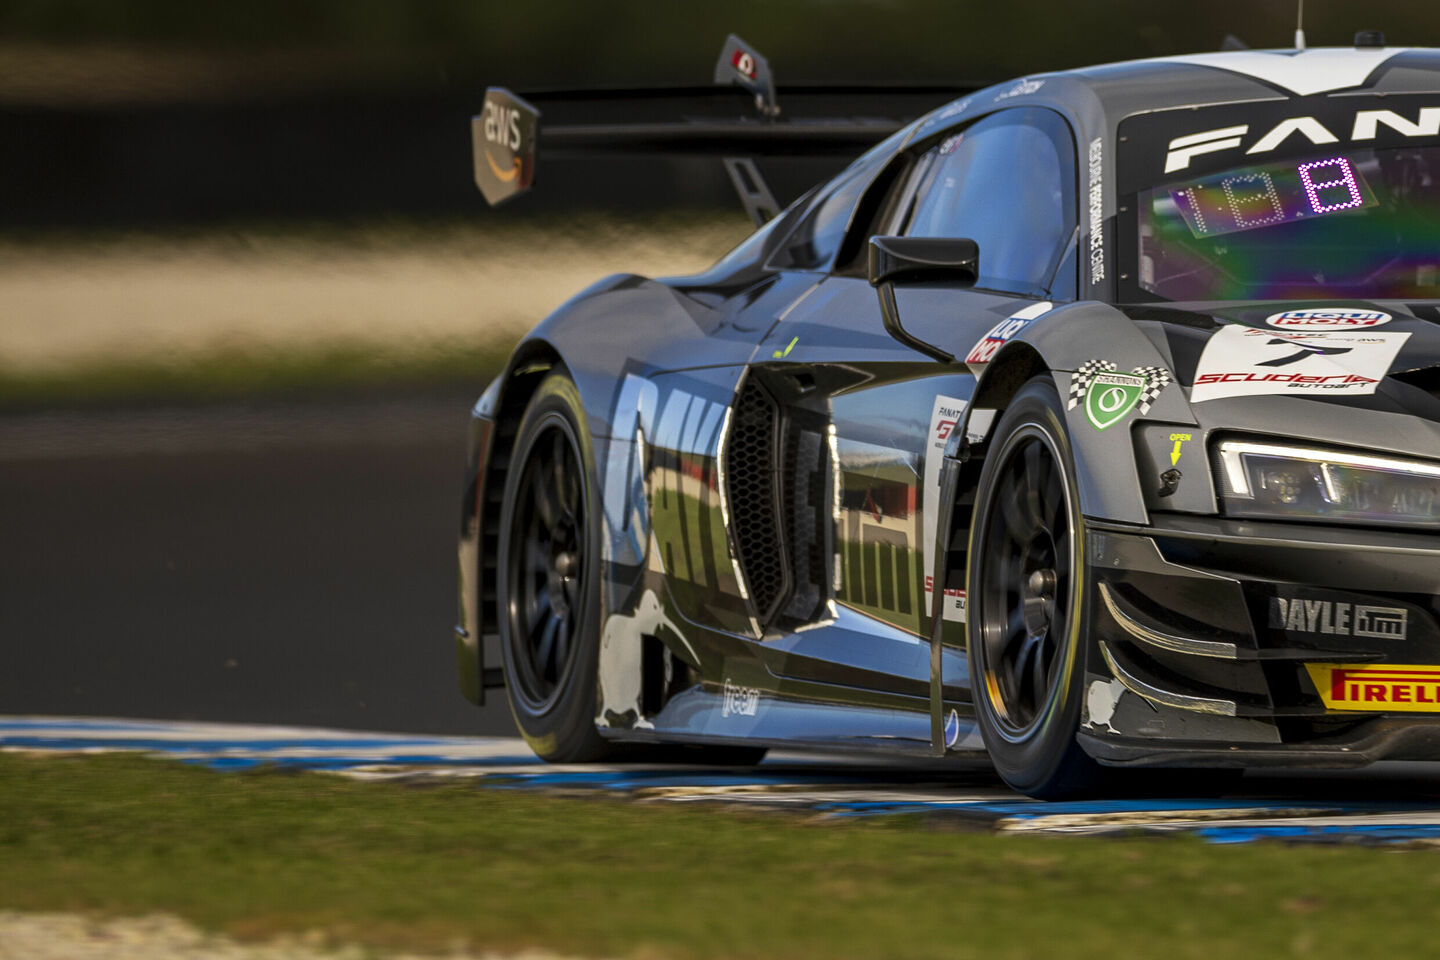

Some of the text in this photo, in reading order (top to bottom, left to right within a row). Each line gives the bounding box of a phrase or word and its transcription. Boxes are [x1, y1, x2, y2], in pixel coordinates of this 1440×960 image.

[1275, 318, 1379, 326] MOLY
[1169, 433, 1192, 441] OPEN
[1269, 596, 1351, 635] DAYLE
